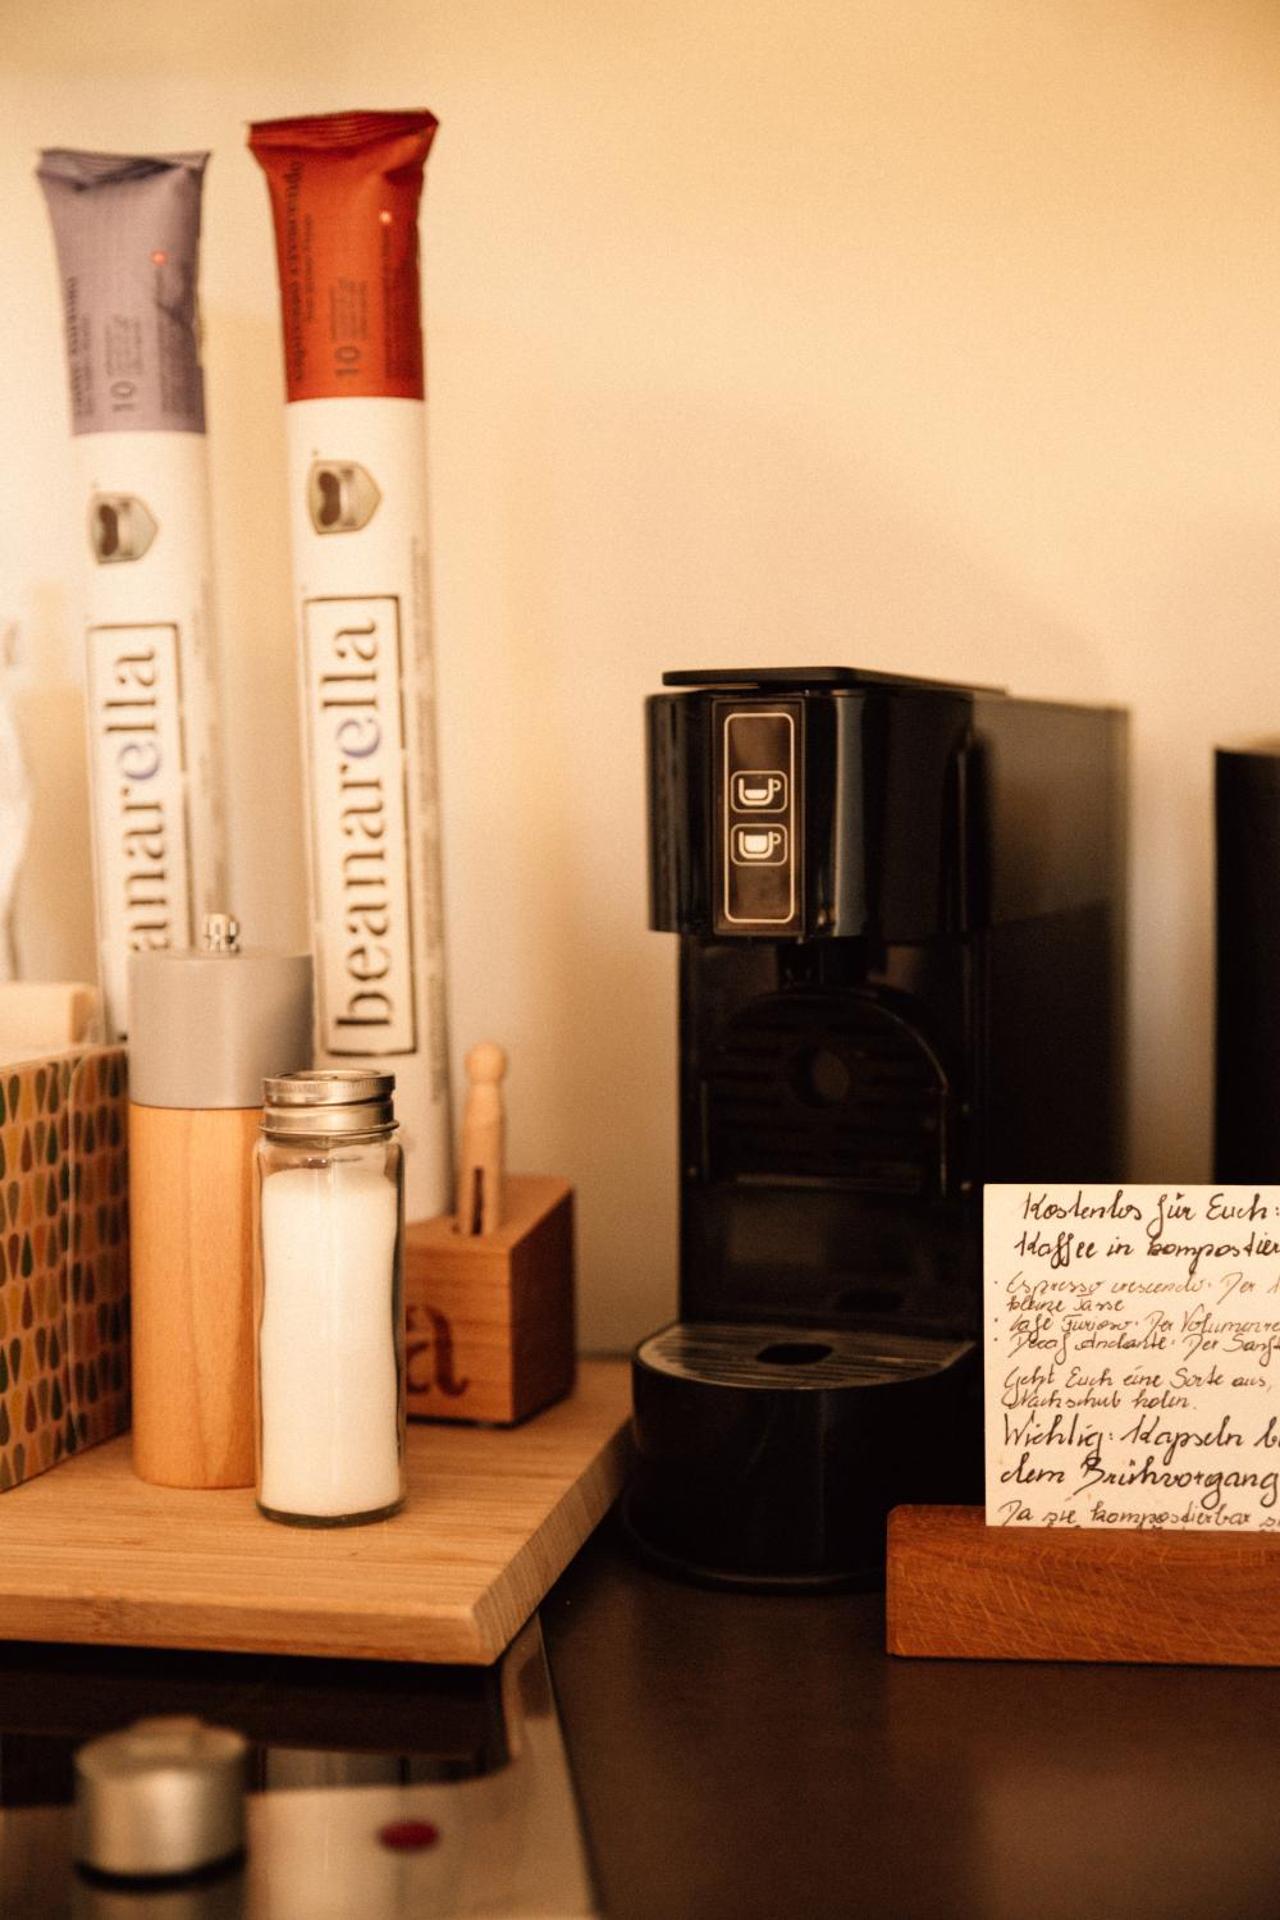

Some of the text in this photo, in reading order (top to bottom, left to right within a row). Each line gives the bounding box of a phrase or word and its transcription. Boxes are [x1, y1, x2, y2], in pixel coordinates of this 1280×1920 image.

[334, 345, 361, 377] 10
[110, 380, 137, 412] 10
[104, 646, 171, 953] anarella
[320, 617, 394, 1027] beanarella
[1023, 1189, 1142, 1221] Kostenlos
[1146, 1192, 1196, 1240] für
[1014, 1230, 1098, 1269] Kaffee
[1107, 1236, 1134, 1257] in
[1065, 1366, 1113, 1388] Euch
[1123, 1365, 1163, 1388] eine
[1169, 1364, 1225, 1389] Sorte
[1120, 1414, 1244, 1466] Kapseln
[1000, 1450, 1279, 1510] dem Brühvorgang
